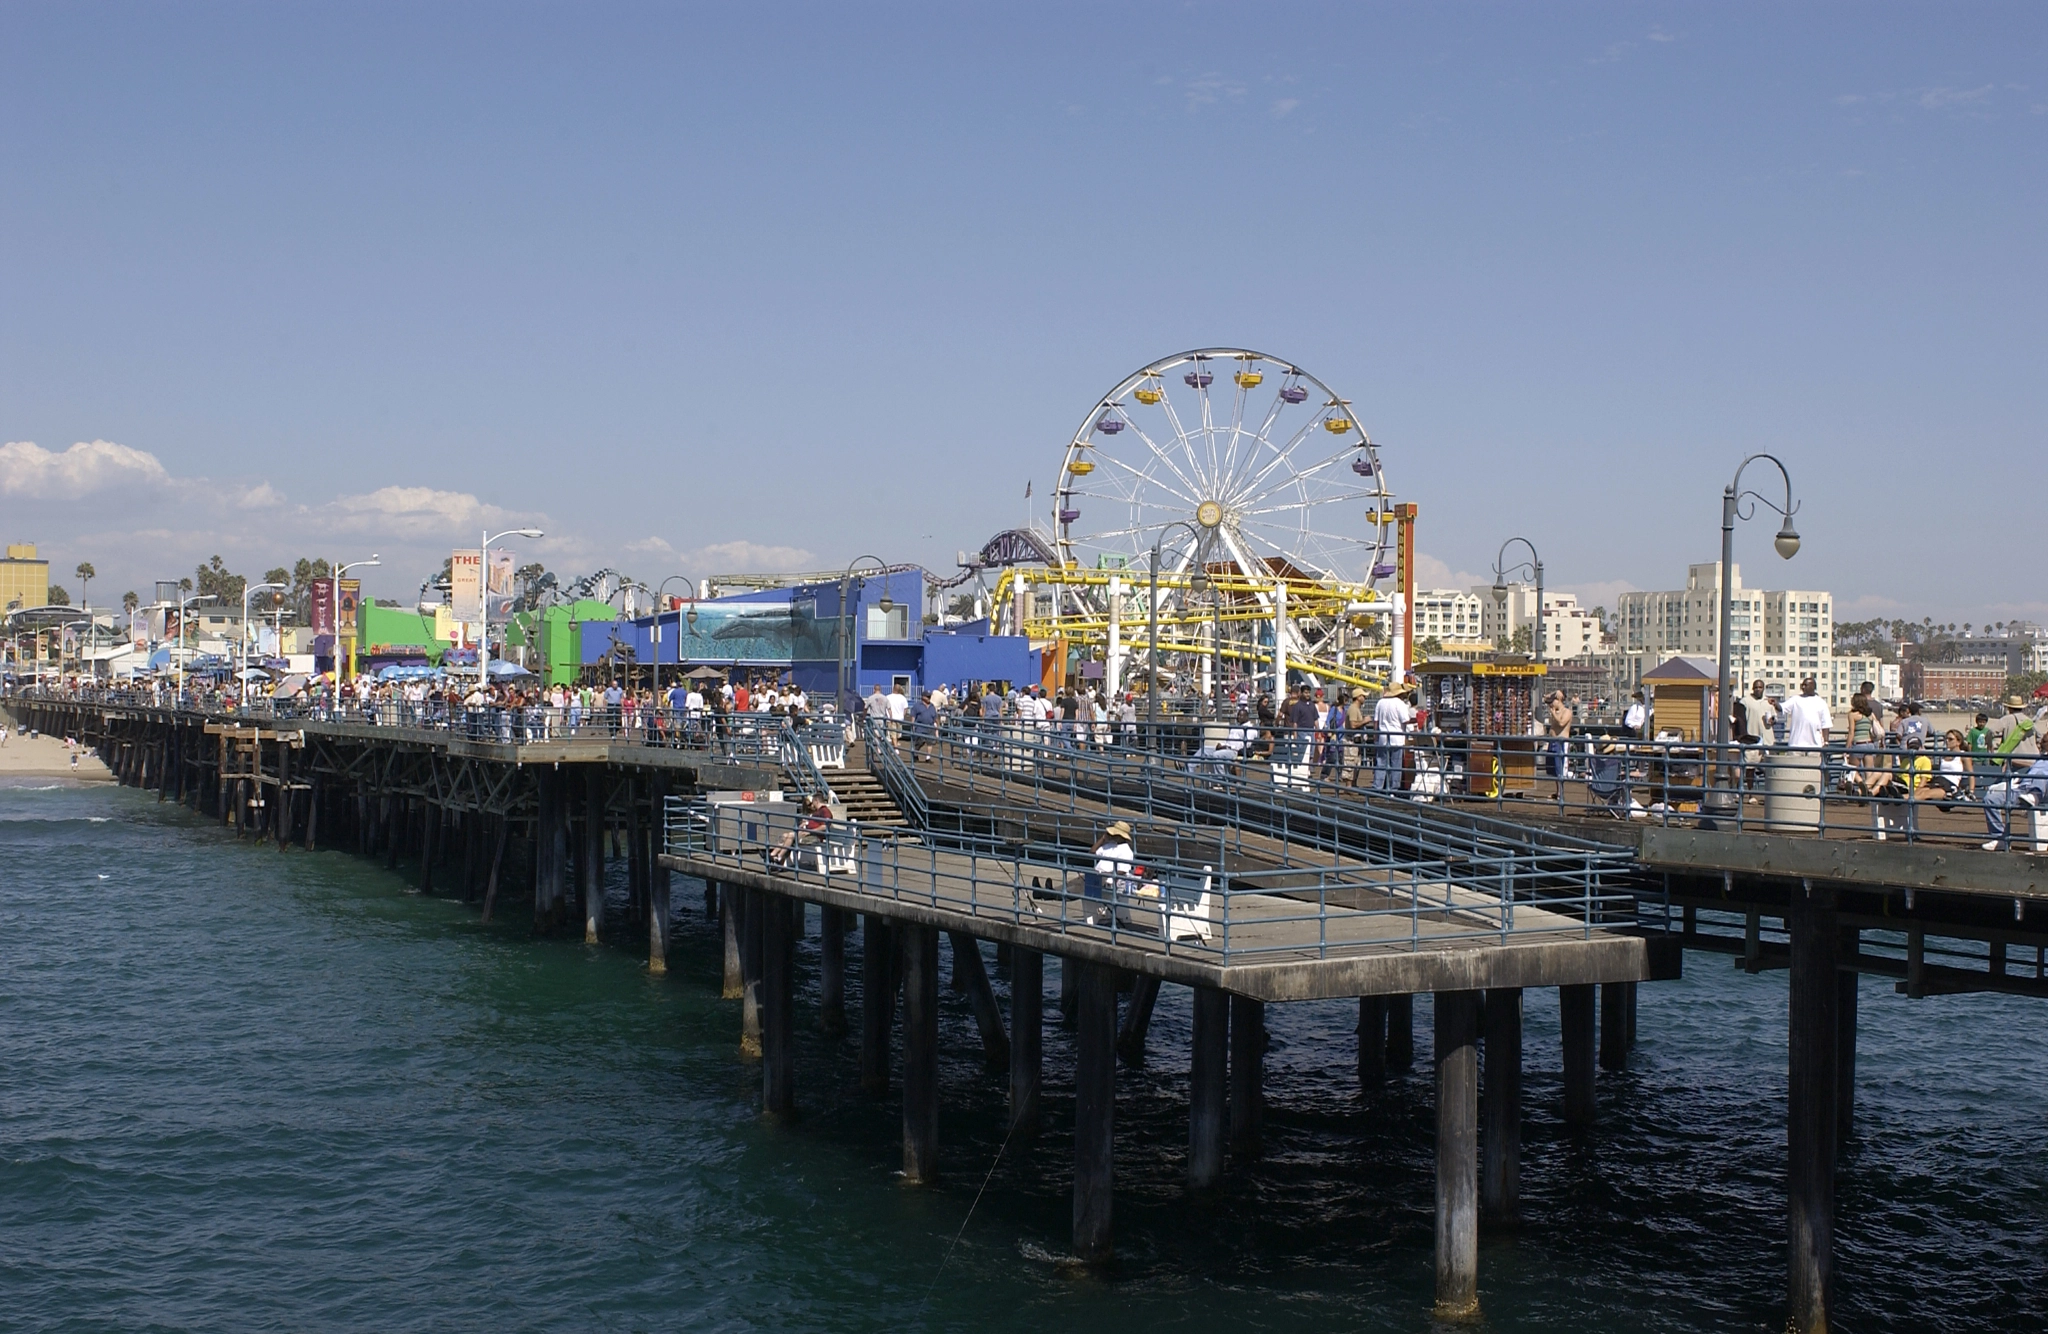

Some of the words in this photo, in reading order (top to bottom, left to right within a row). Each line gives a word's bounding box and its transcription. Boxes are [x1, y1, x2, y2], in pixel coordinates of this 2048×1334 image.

[454, 556, 480, 565] THE
[1486, 665, 1508, 673] RED
[1510, 665, 1536, 673] LINE
